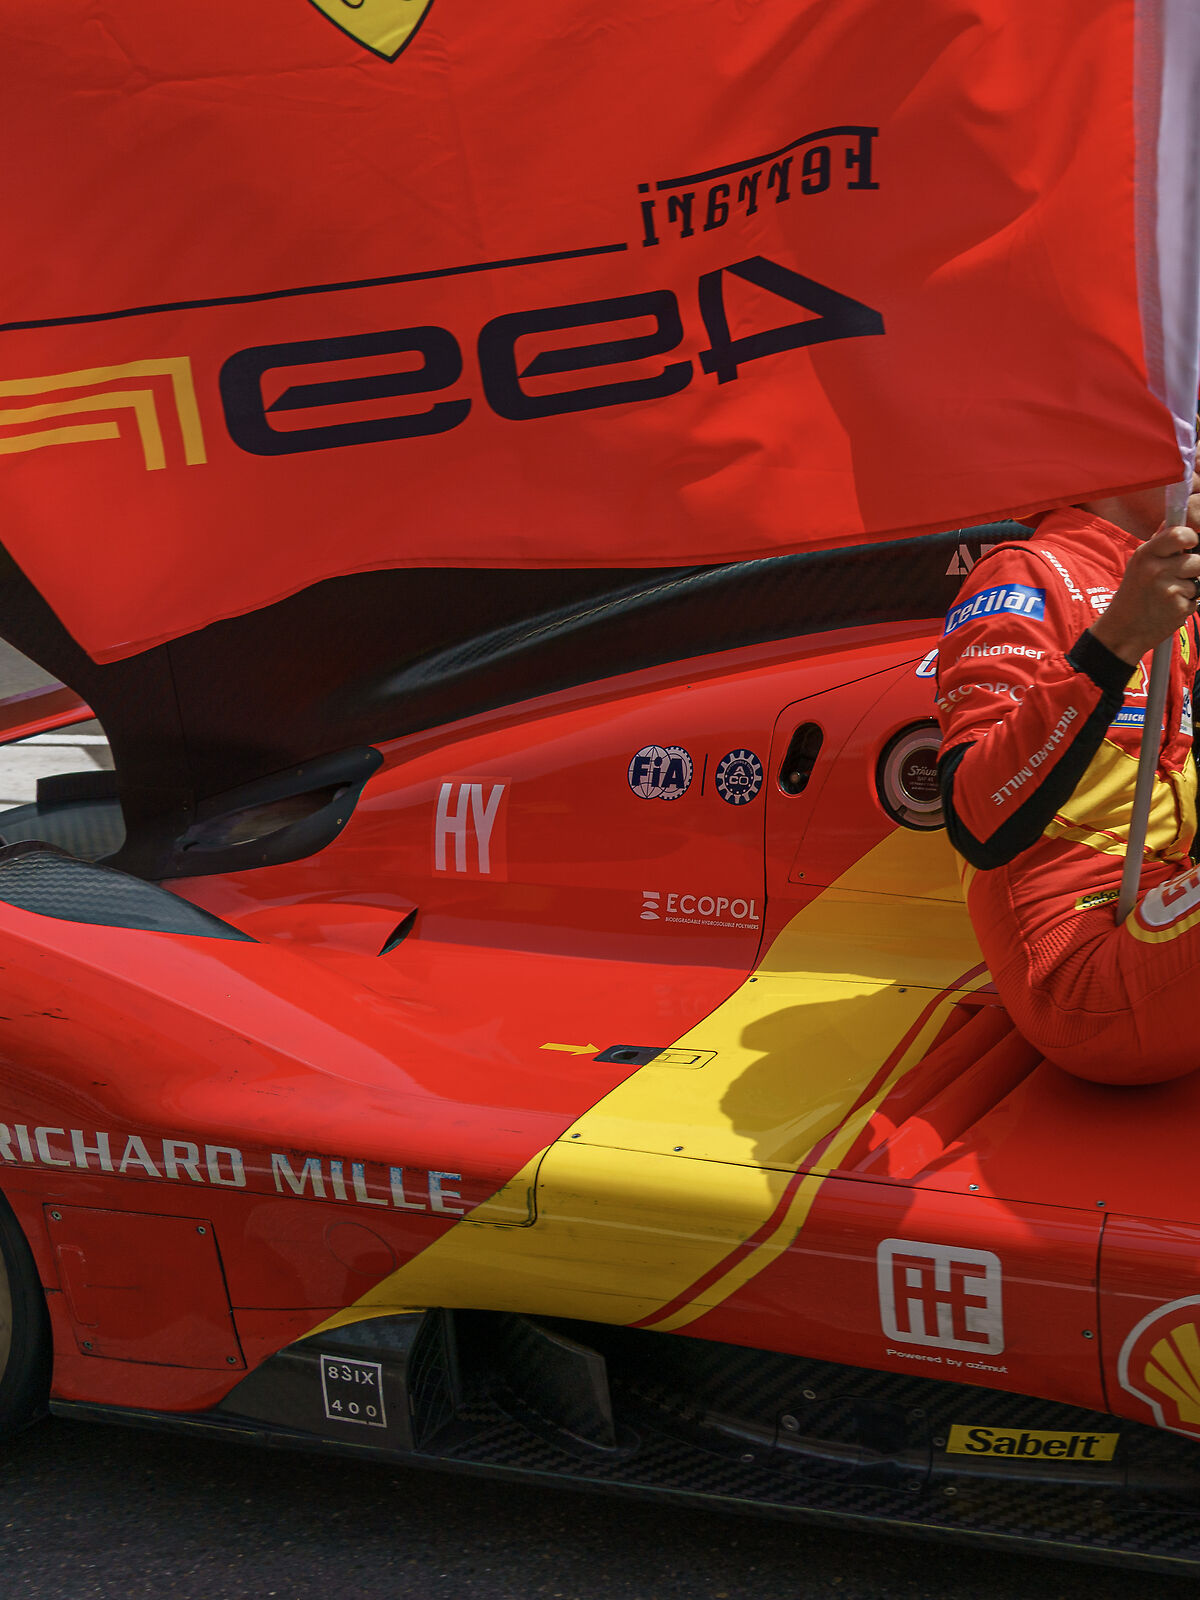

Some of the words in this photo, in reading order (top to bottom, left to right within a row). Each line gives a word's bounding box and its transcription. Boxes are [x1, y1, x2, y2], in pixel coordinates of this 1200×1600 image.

[960, 643, 1046, 660] antander
[1117, 713, 1145, 722] MICH
[990, 766, 1034, 806] MILLE
[435, 783, 505, 874] HY
[666, 893, 760, 920] ECOPOL
[1081, 889, 1121, 908] Sabe
[271, 1153, 464, 1215] MILLE
[886, 1348, 942, 1364] Powered
[945, 1357, 963, 1368] by
[965, 1361, 1009, 1374] azimut
[327, 1364, 375, 1386] 8SIX
[331, 1399, 377, 1417] 400
[965, 1428, 1100, 1459] Sabelt
